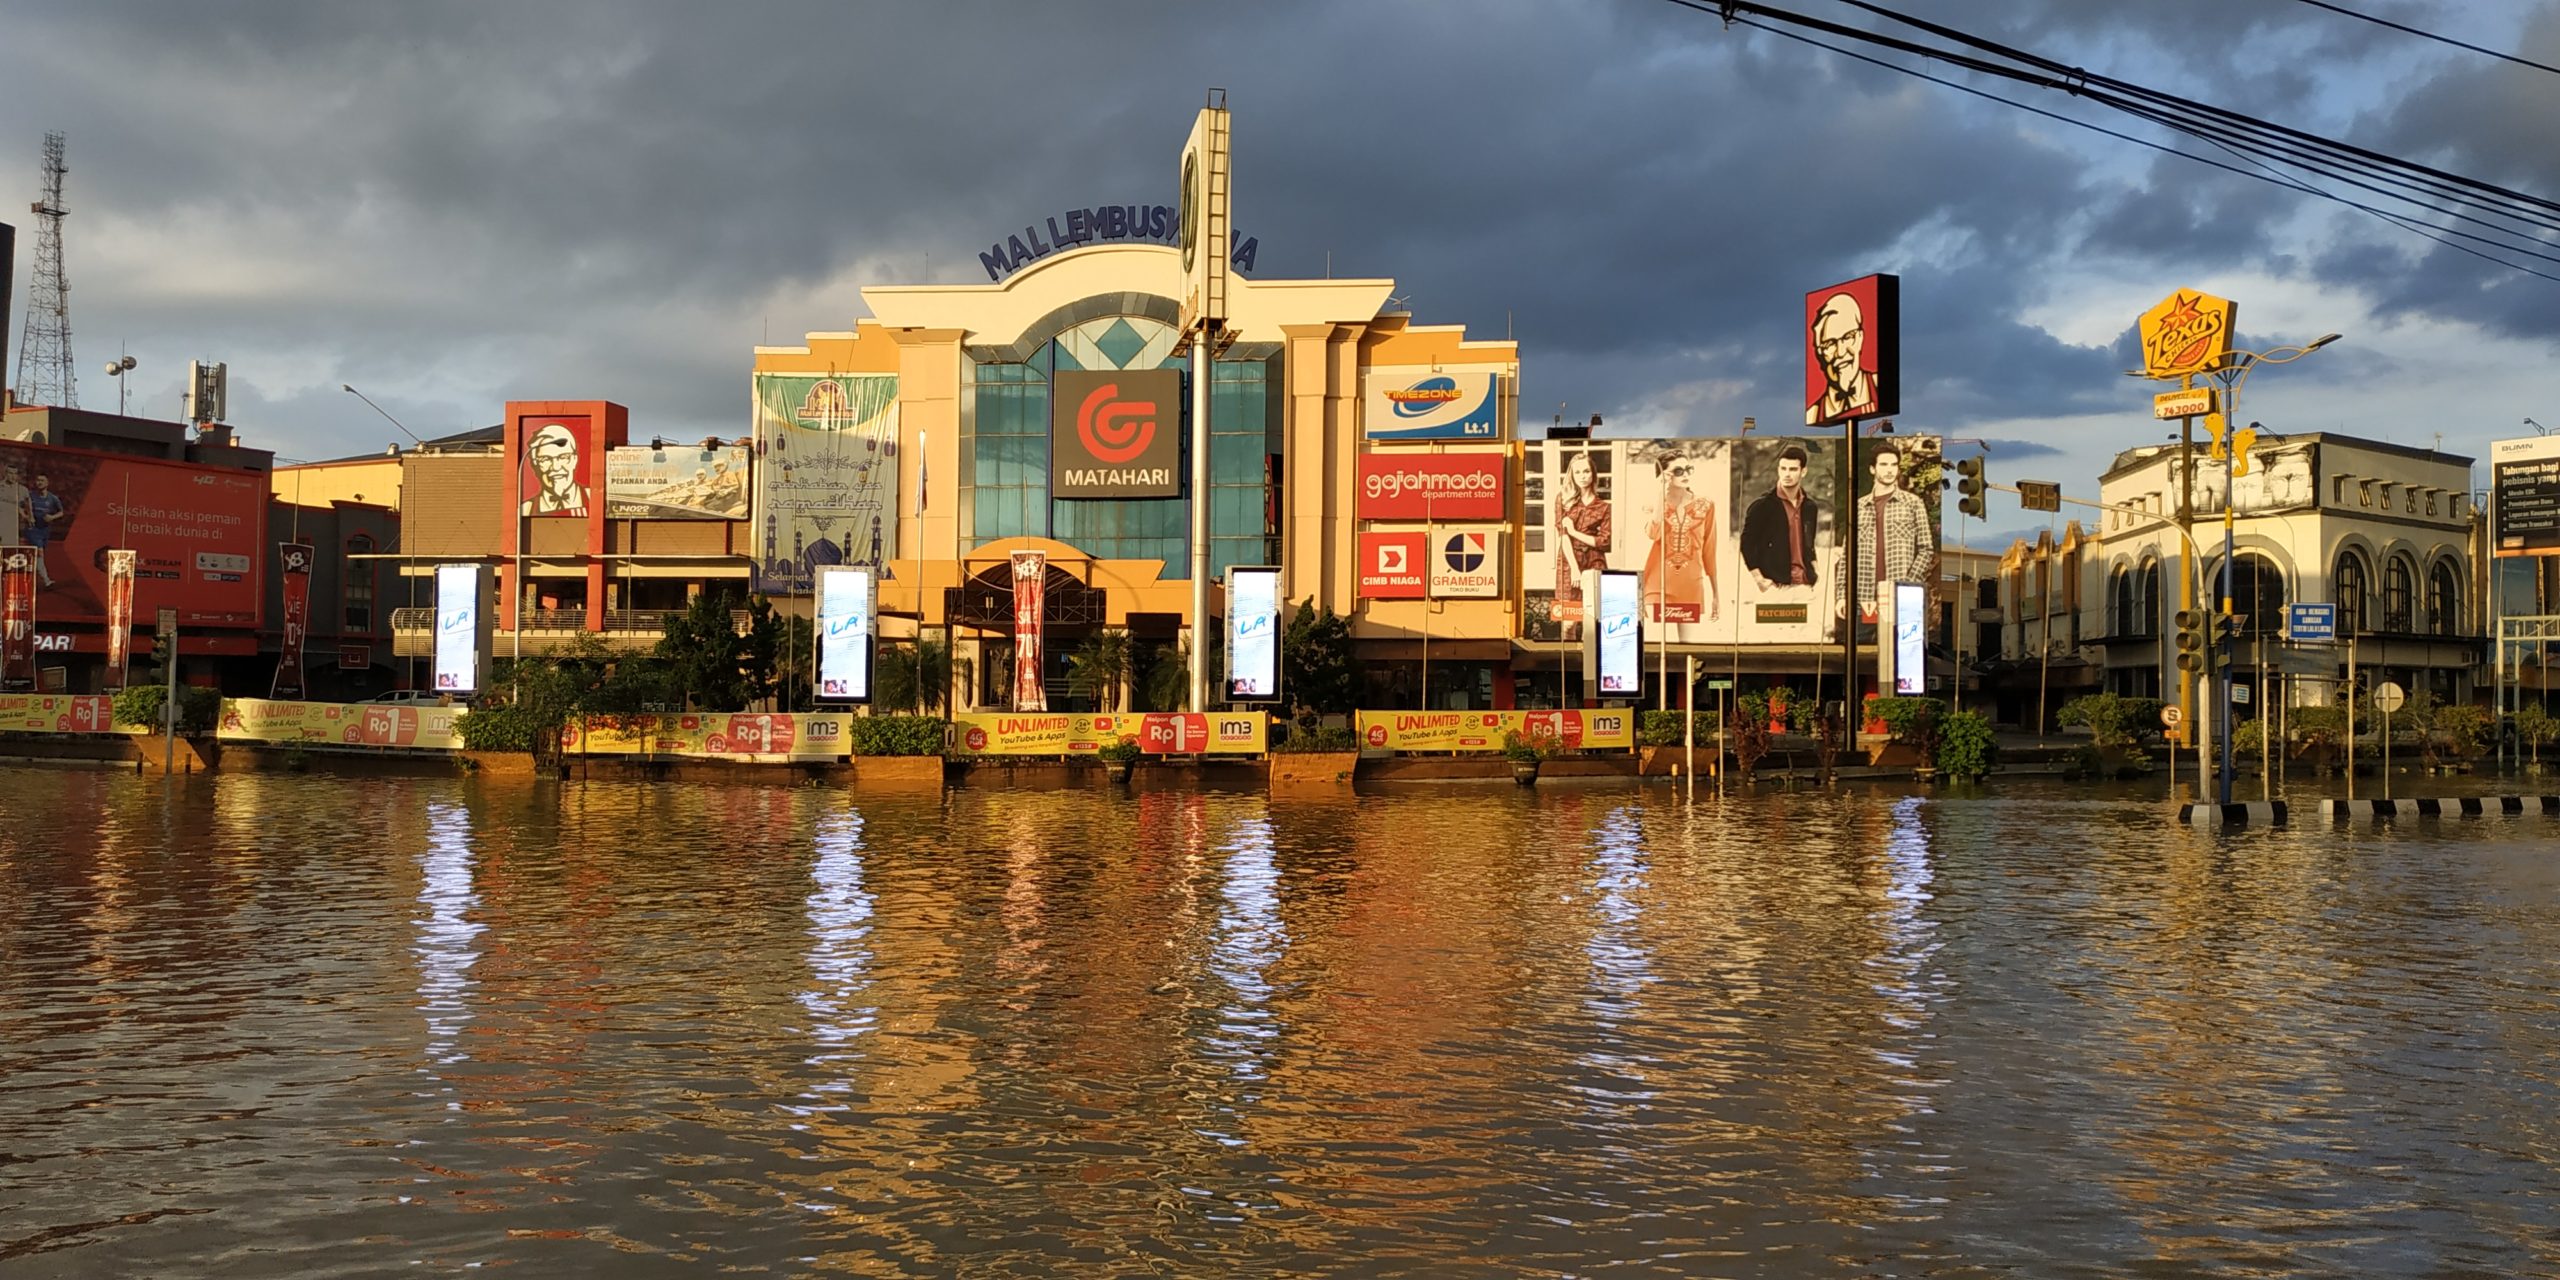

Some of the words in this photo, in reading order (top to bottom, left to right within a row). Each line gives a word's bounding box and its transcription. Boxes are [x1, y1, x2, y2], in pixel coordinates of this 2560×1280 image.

[979, 226, 1049, 281] MAL
[2148, 309, 2222, 369] Texas
[1383, 386, 1463, 400] TIMEZONE
[2164, 402, 2205, 416] 743000
[1464, 422, 1489, 434] Lt.1
[2502, 443, 2533, 452] BUMN
[1065, 468, 1169, 486] MATAHARI
[2502, 465, 2540, 476] Tabungan
[2541, 462, 2559, 474] bagi
[1366, 470, 1497, 498] gajahmada
[1422, 490, 1472, 500] department
[1474, 490, 1496, 499] store
[107, 502, 165, 519] Saksikan
[169, 509, 194, 521] aksi
[197, 512, 241, 526] pemain
[619, 505, 650, 513] 14022
[127, 521, 172, 535] terbaik
[175, 525, 208, 539] dunia
[212, 527, 223, 540] di
[1362, 577, 1388, 586] CIMB
[1390, 576, 1422, 585] NIAGA
[1432, 576, 1496, 586] GRAMEDIA
[445, 610, 469, 630] LA
[831, 616, 859, 635] LA
[1240, 615, 1267, 635] LA
[1607, 615, 1631, 635] LA
[250, 704, 306, 719] UNLIMITED
[2168, 709, 2178, 721] S
[807, 718, 839, 736] im3
[998, 717, 1070, 735] UNLIMITED
[1220, 718, 1252, 735] im3
[1396, 715, 1461, 732] UNLIMITED
[1593, 714, 1621, 730] im3
[1000, 735, 1036, 744] YouTube
[1045, 732, 1066, 742] Apps
[1399, 732, 1430, 741] YouTube
[1439, 729, 1457, 738] Apps
